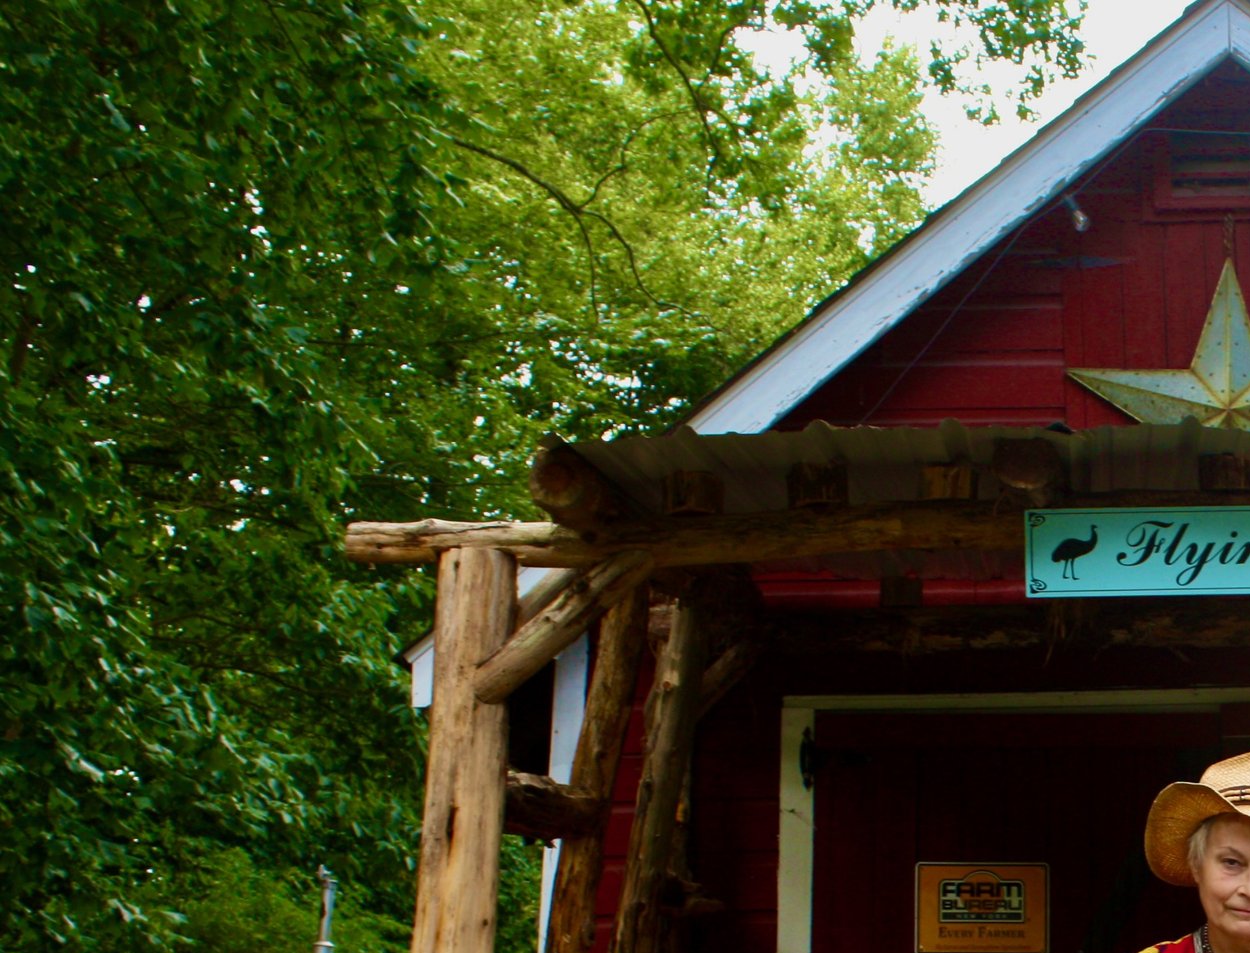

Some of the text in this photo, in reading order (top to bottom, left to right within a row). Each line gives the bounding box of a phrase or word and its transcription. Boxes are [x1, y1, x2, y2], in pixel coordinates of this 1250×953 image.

[941, 882, 1023, 898] FARM
[941, 899, 1023, 911] BUREAU
[978, 926, 1026, 939] FARMER
